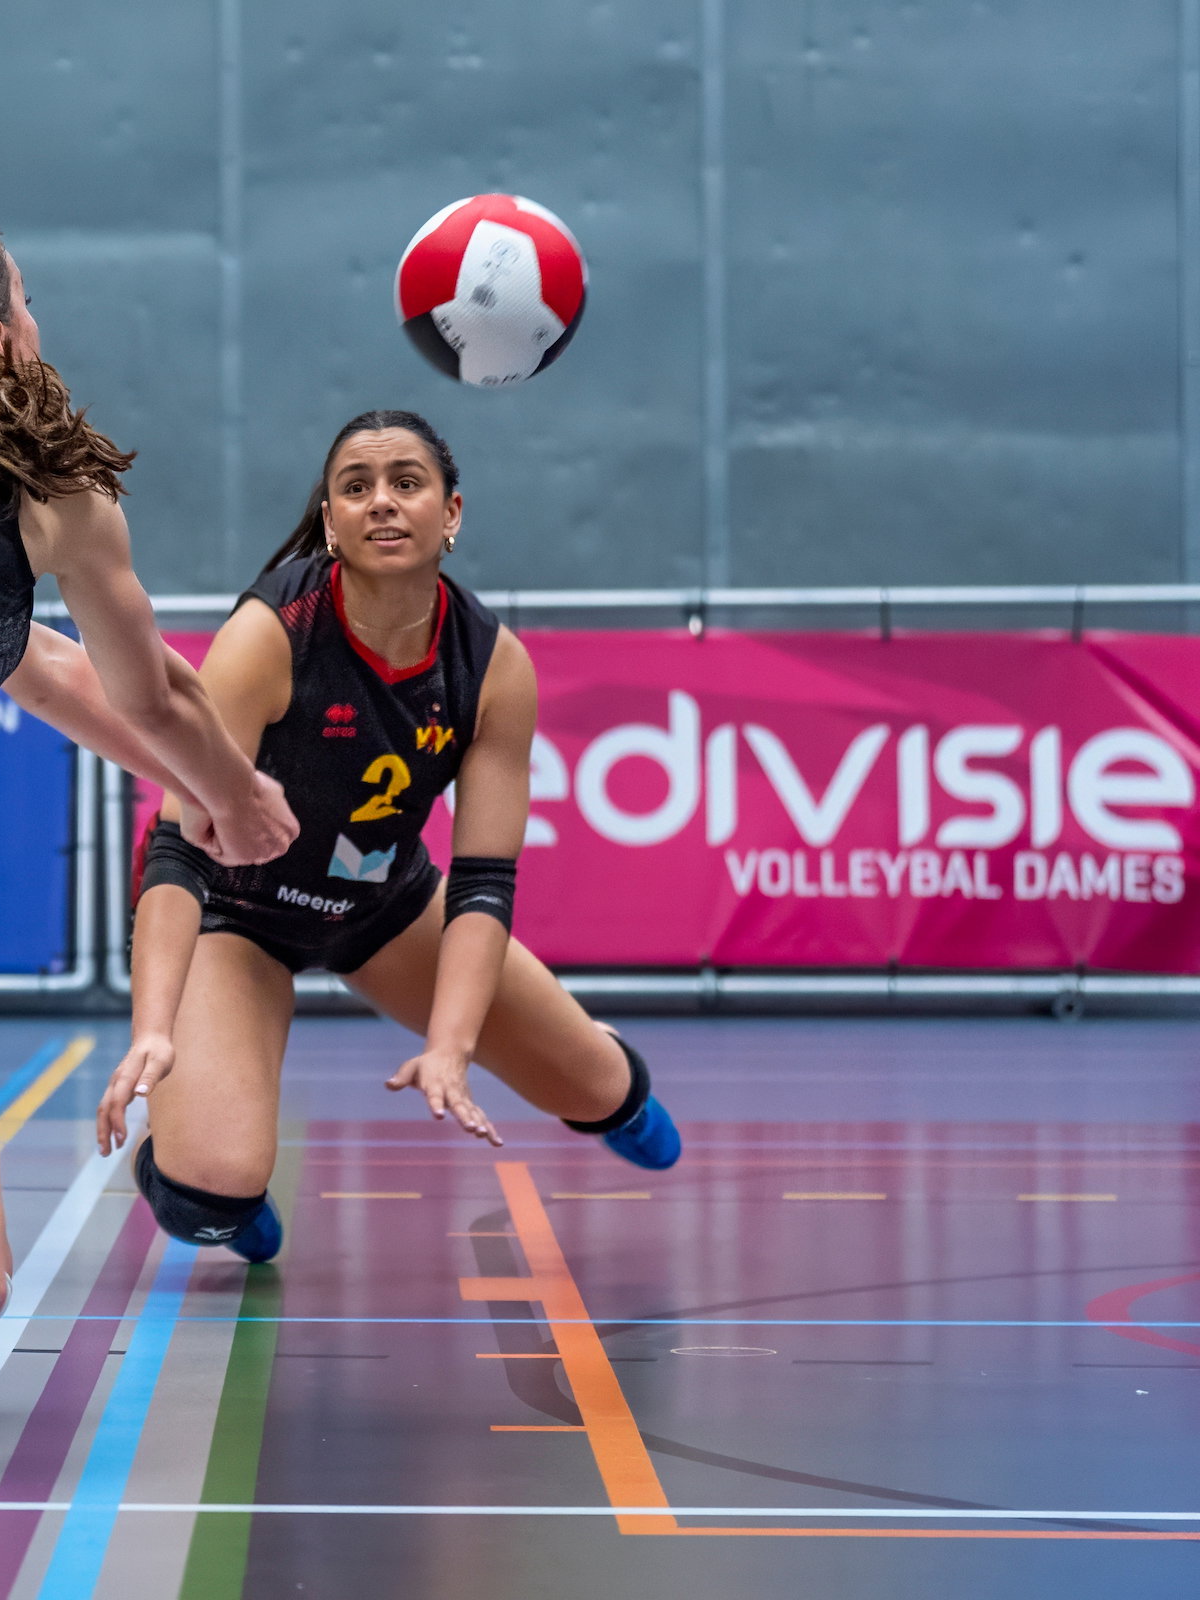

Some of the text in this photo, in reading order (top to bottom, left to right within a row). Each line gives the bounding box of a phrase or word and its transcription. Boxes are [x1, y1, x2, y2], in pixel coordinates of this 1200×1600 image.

[350, 754, 411, 822] 2
[276, 884, 355, 914] Meerd
[724, 849, 1186, 903] VOLLEYBAL DAMES
